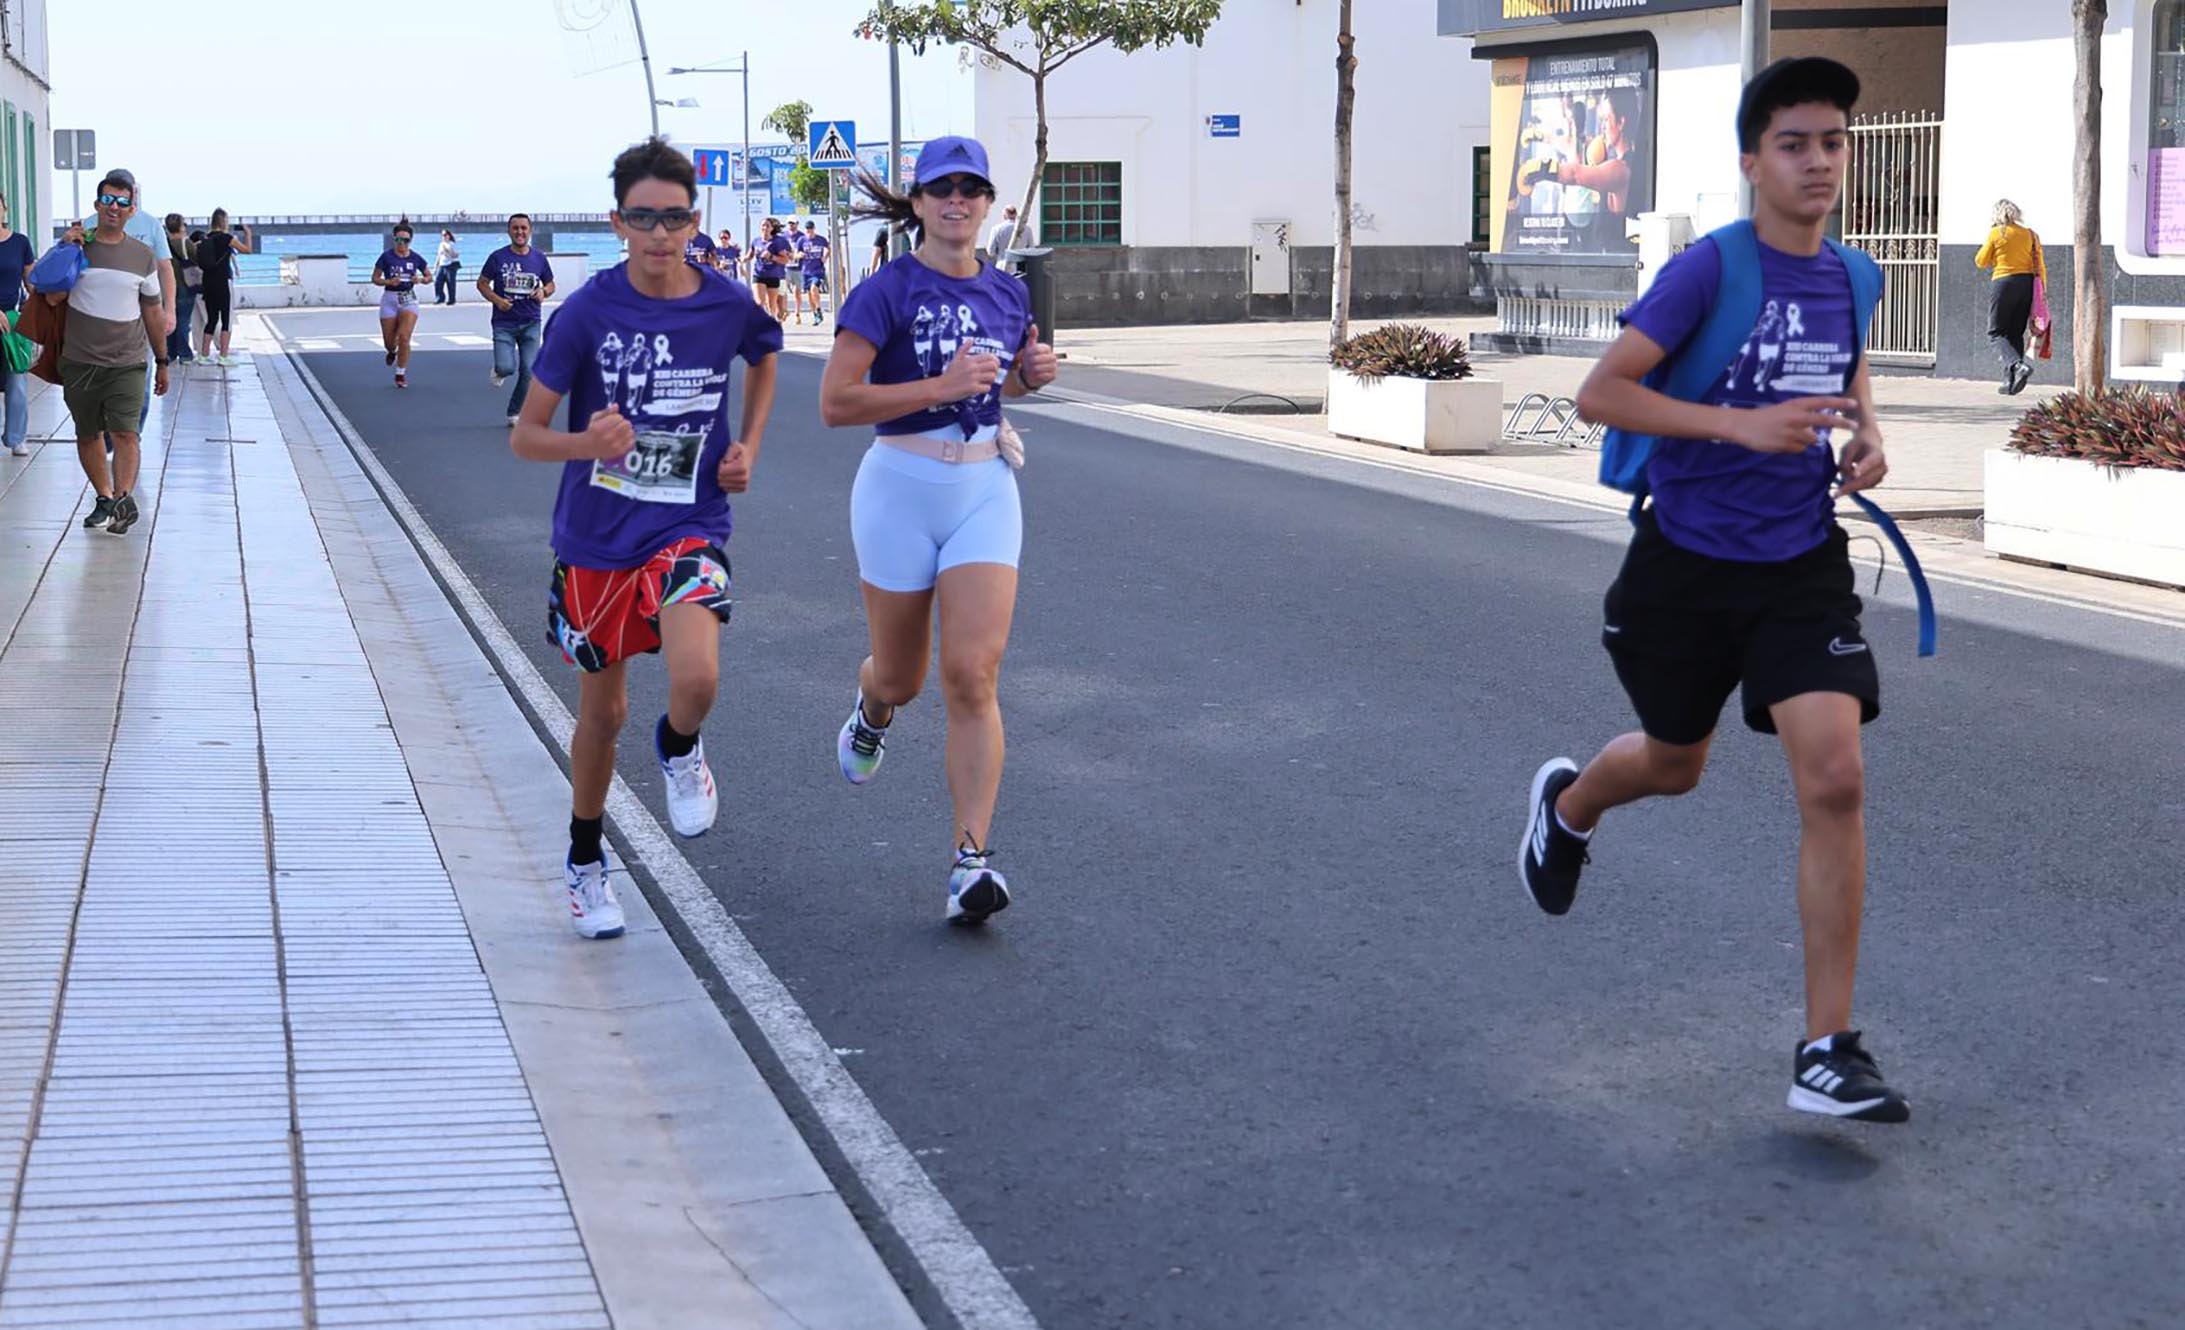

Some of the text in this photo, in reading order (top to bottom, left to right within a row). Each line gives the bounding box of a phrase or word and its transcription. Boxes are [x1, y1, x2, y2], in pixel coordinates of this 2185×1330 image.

[1802, 342, 1838, 352] CARRERA
[1784, 353, 1819, 362] CONTRA
[1820, 353, 1830, 362] LA
[1782, 363, 1795, 372] DE
[672, 368, 714, 378] CARRERA
[654, 380, 691, 388] CONTRA
[692, 379, 704, 387] LA
[652, 388, 665, 397] DE
